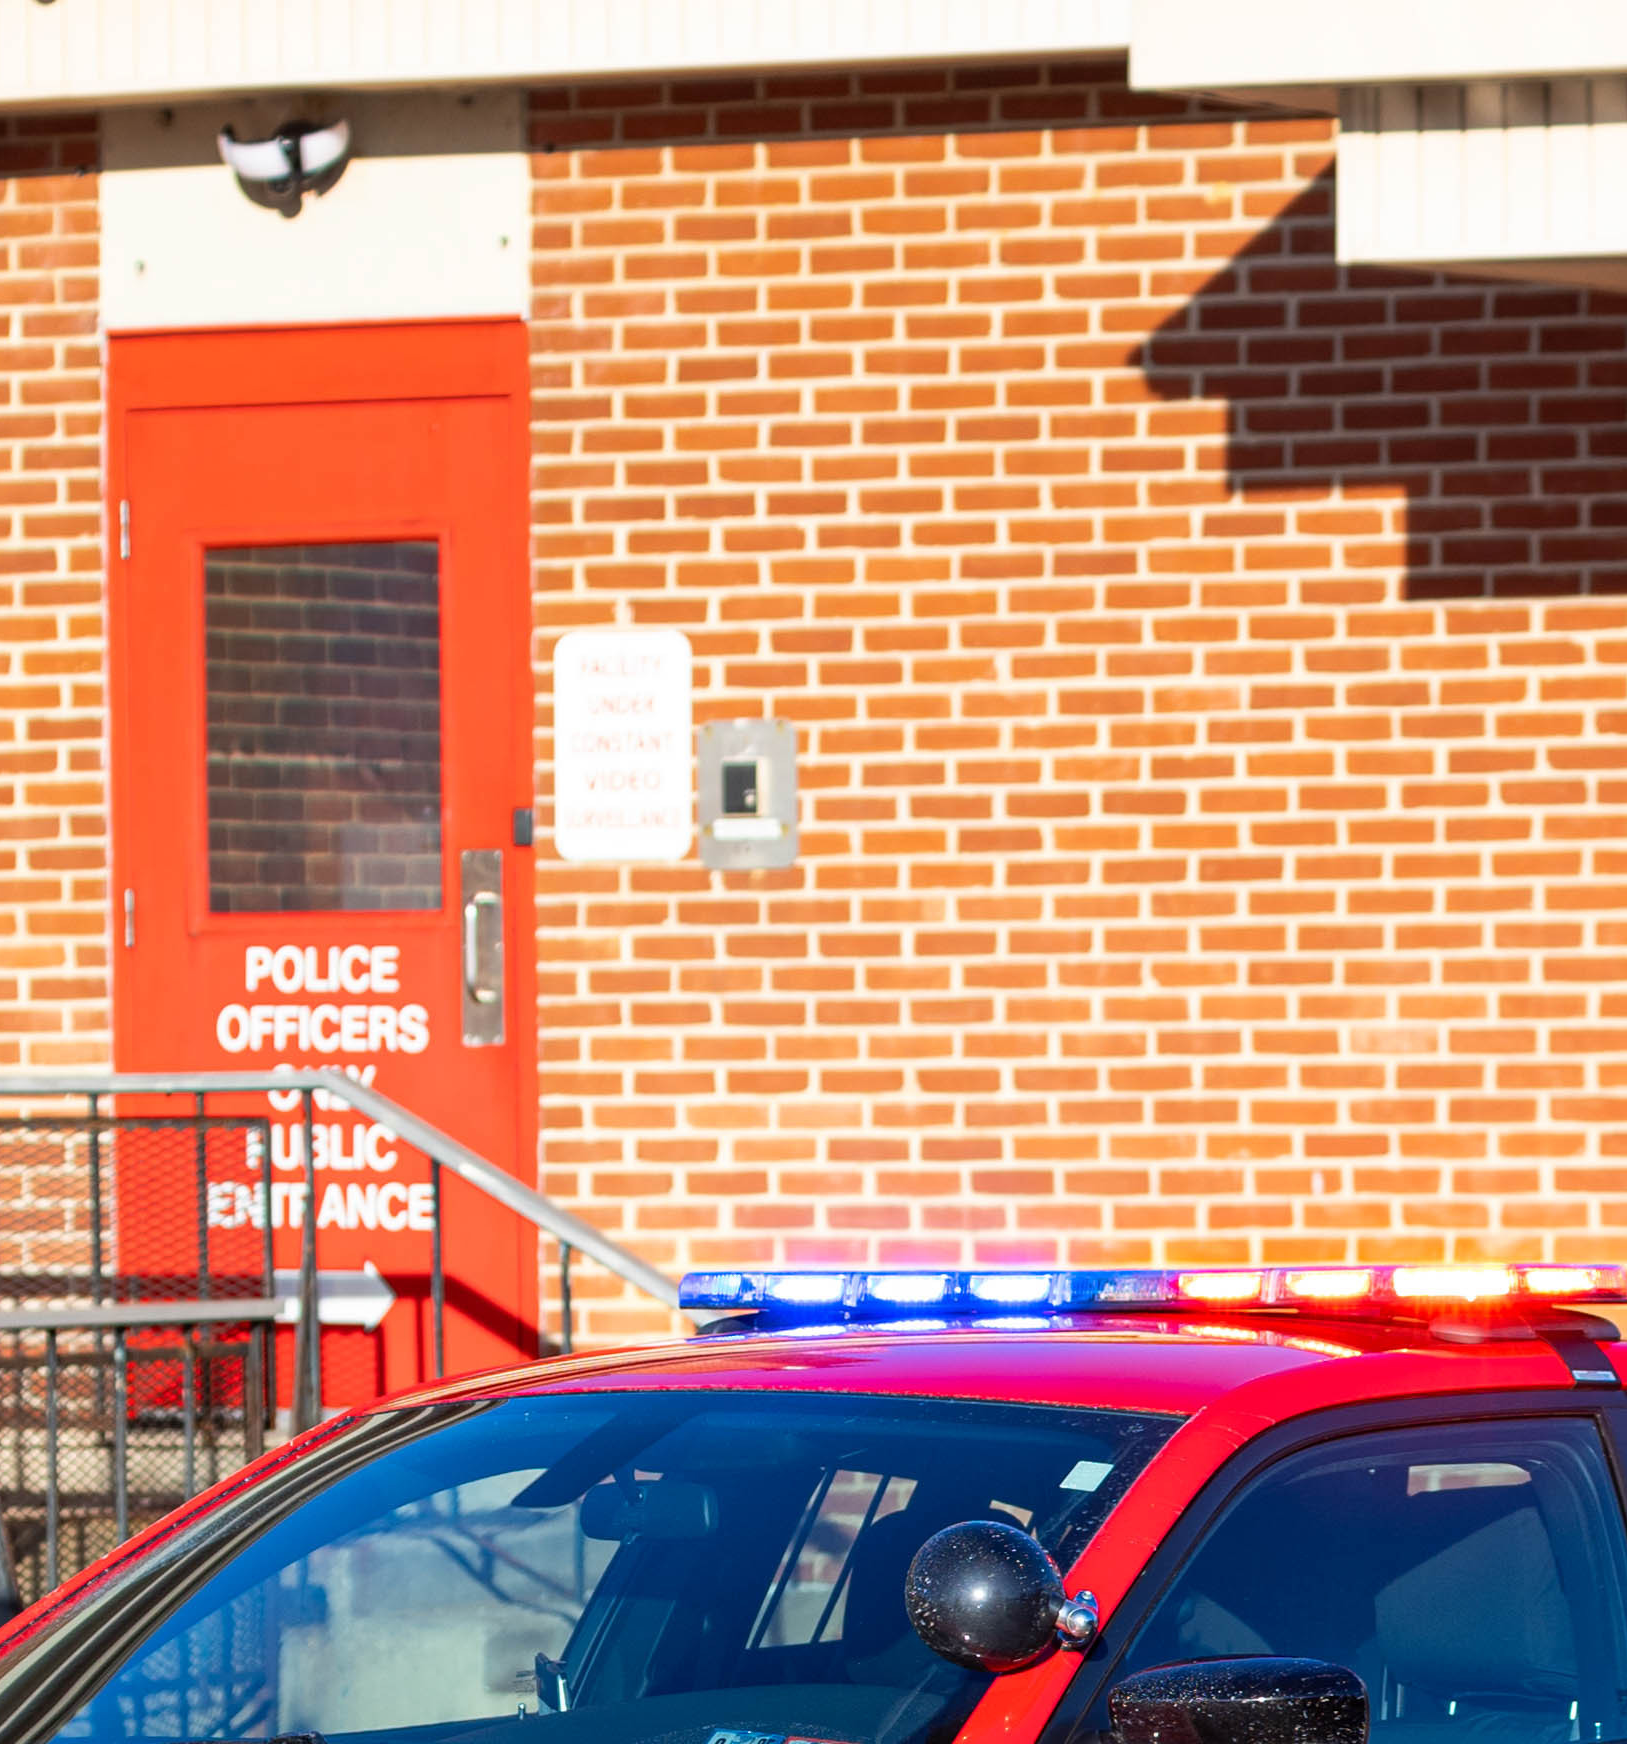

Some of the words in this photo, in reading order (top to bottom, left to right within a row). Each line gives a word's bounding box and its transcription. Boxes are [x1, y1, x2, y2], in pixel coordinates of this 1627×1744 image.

[587, 694, 655, 715] UNDER
[570, 731, 675, 753] CONSTANT
[583, 770, 662, 791] VIDEO
[245, 945, 400, 994] POLICE
[216, 1004, 430, 1053] OFFICERS
